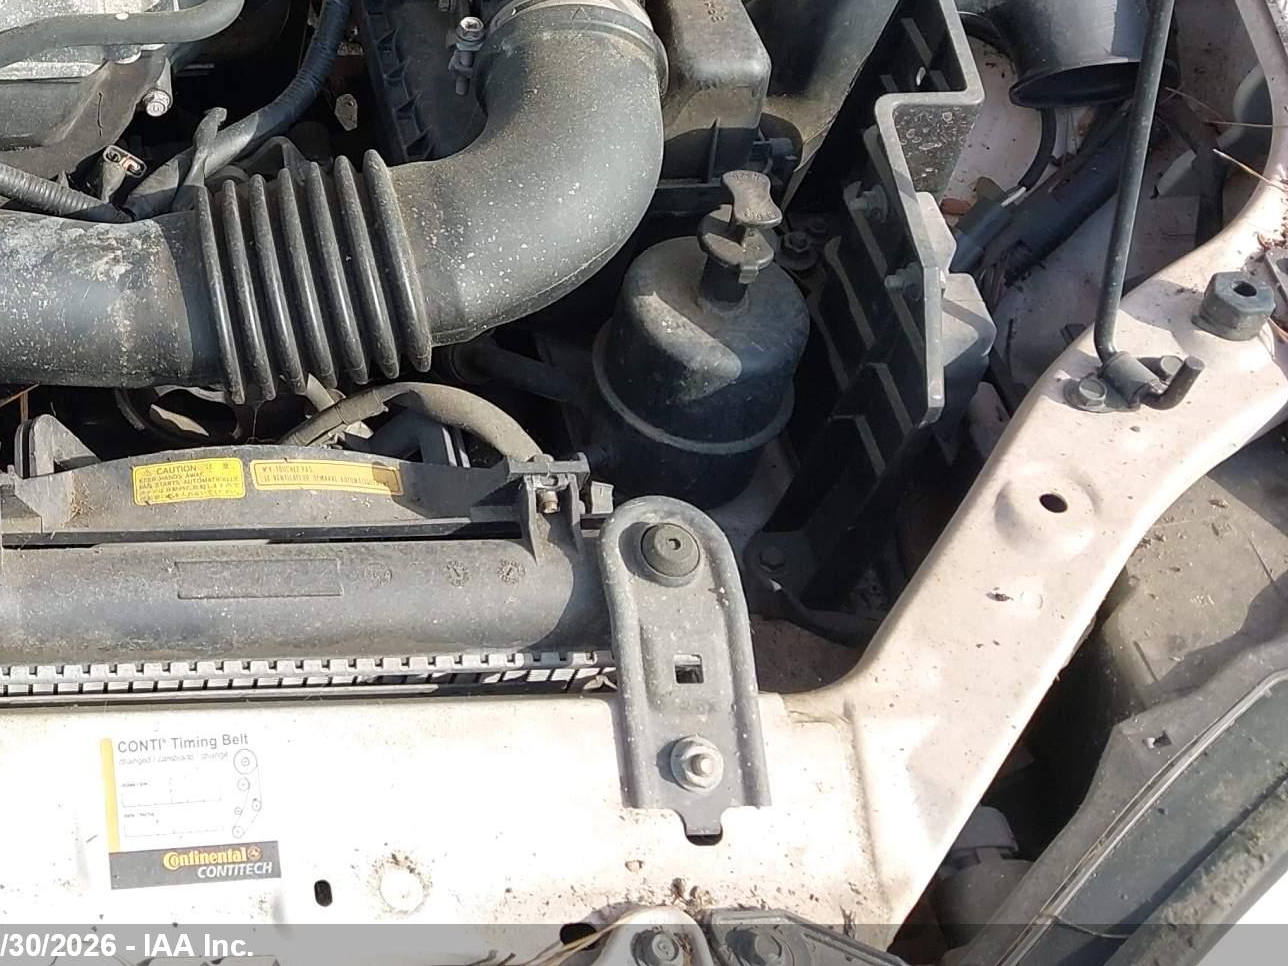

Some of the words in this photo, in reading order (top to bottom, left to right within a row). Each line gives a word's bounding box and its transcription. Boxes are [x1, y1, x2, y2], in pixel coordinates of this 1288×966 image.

[156, 465, 196, 475] CAUTION
[171, 736, 217, 751] Timing
[222, 733, 249, 746] Belt
[163, 846, 247, 870] Continental
[197, 861, 273, 879] CONTITECH
